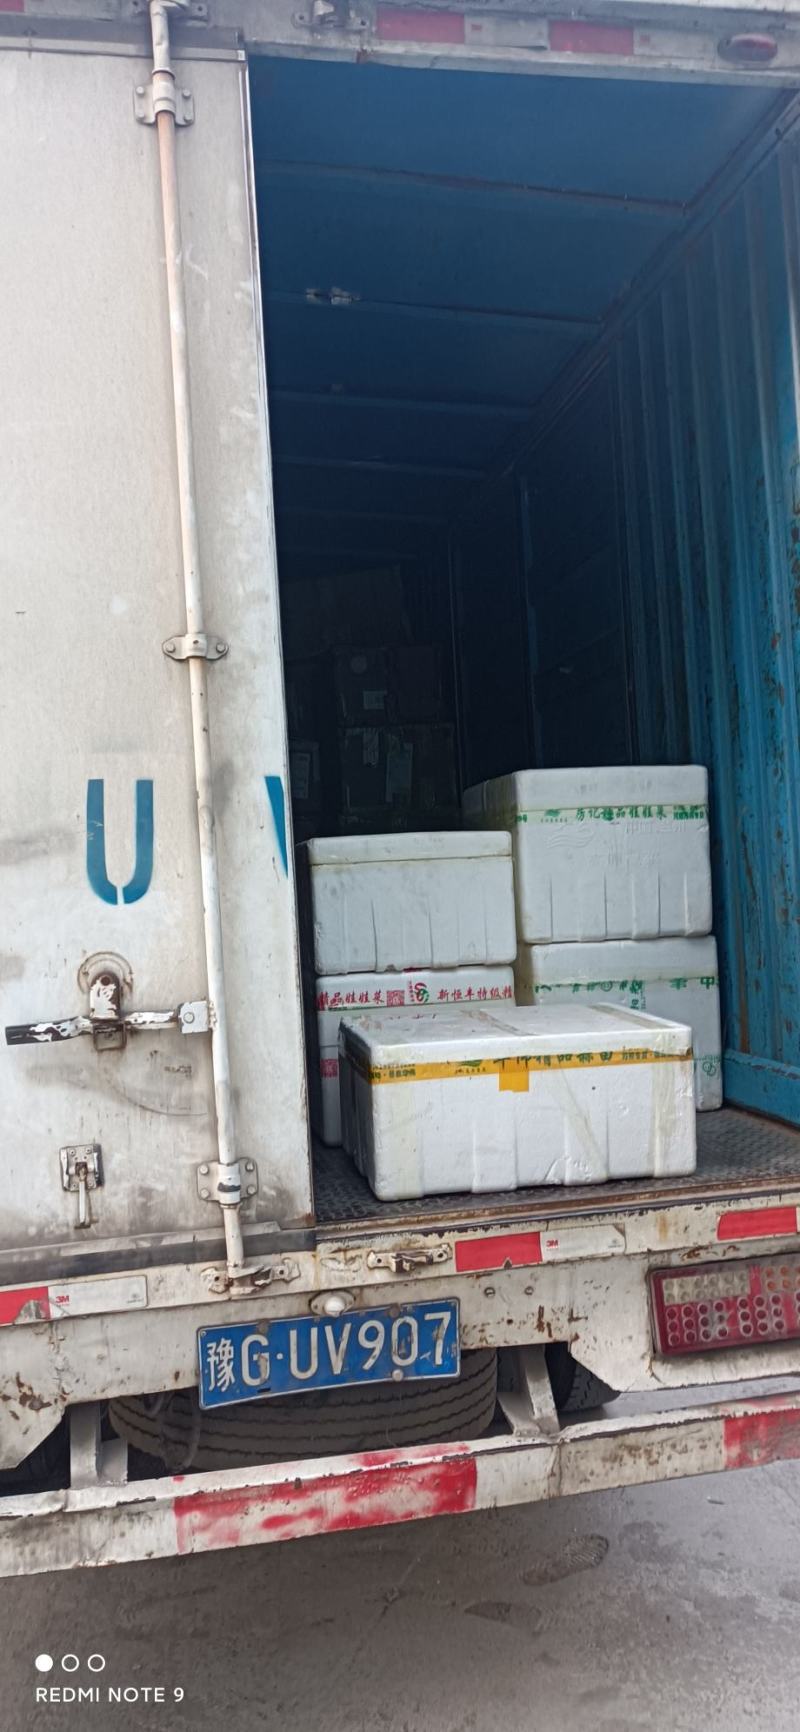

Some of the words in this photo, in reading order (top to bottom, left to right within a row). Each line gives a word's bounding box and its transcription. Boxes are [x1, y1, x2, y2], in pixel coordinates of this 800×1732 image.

[86, 778, 154, 905] U
[546, 1239, 559, 1247] 3M
[55, 1295, 70, 1303] 3M
